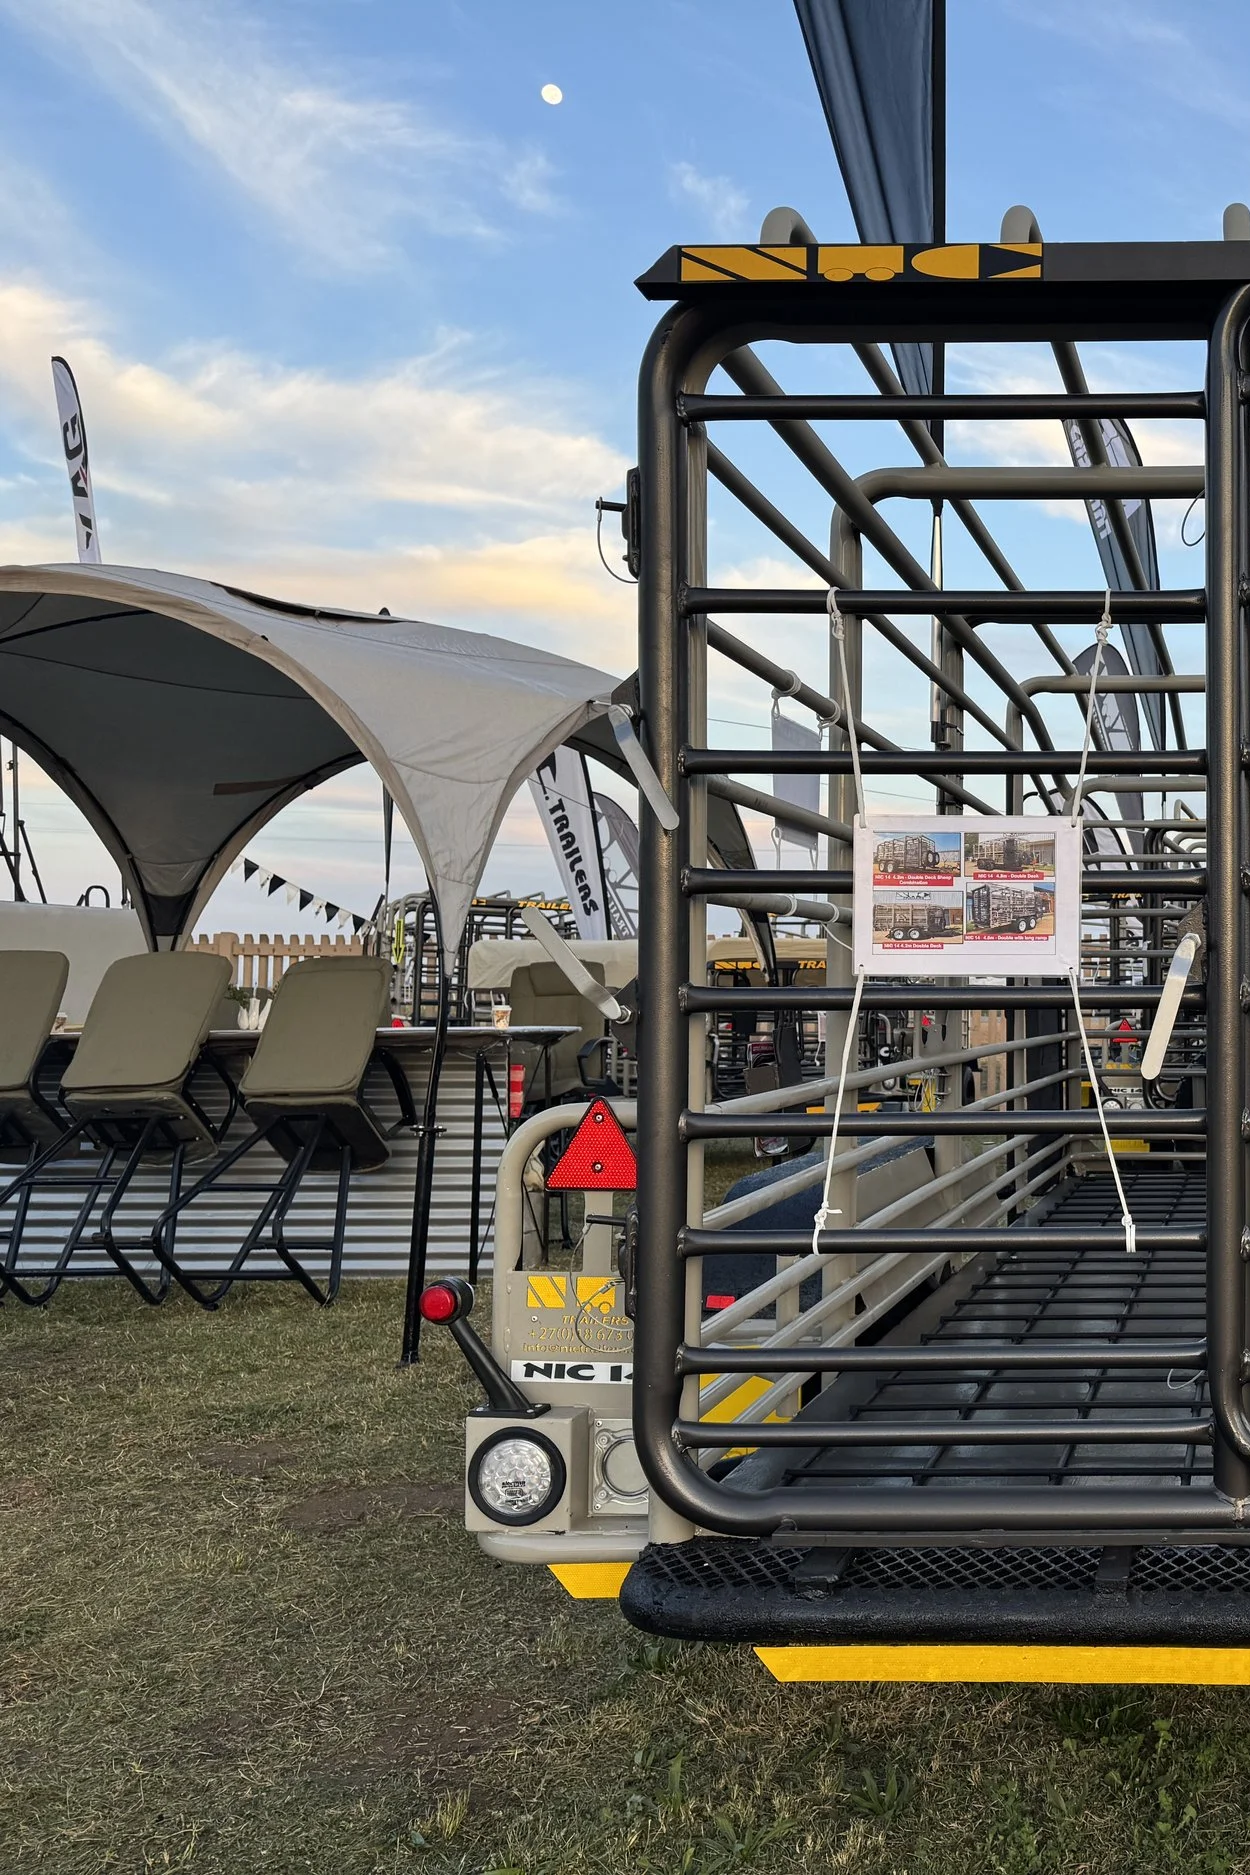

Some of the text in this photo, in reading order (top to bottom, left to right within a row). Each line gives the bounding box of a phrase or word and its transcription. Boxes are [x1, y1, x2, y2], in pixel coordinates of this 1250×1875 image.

[548, 798, 600, 917] TRAILERS
[523, 1362, 633, 1382] NIC 1
